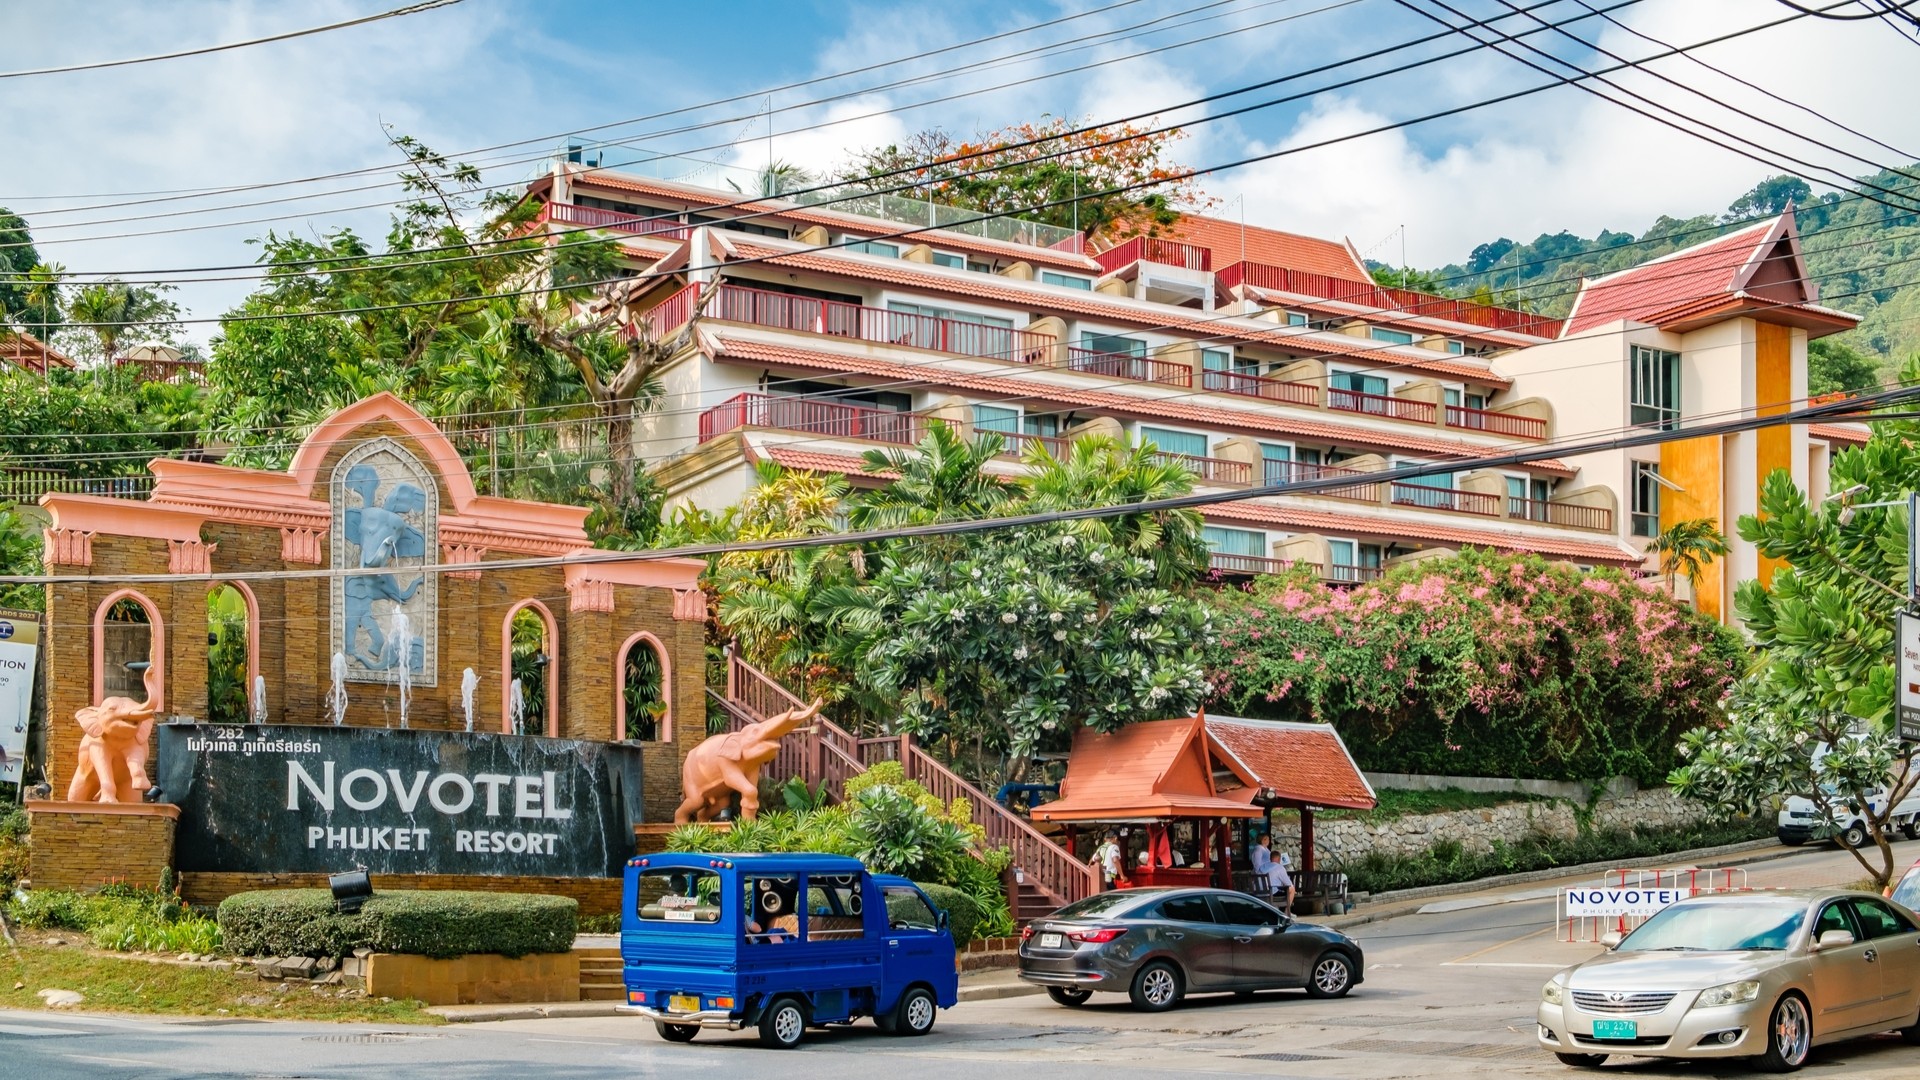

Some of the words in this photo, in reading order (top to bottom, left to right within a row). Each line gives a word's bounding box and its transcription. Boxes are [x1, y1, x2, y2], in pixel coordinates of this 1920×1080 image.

[1904, 646, 1919, 661] Seven
[217, 728, 244, 739] 282
[187, 737, 236, 752] โนโวเทล
[286, 760, 572, 819] NOVOTEL
[308, 826, 431, 850] PHUKET
[456, 830, 558, 855] RESORT
[1613, 1021, 1634, 1031] 2276
